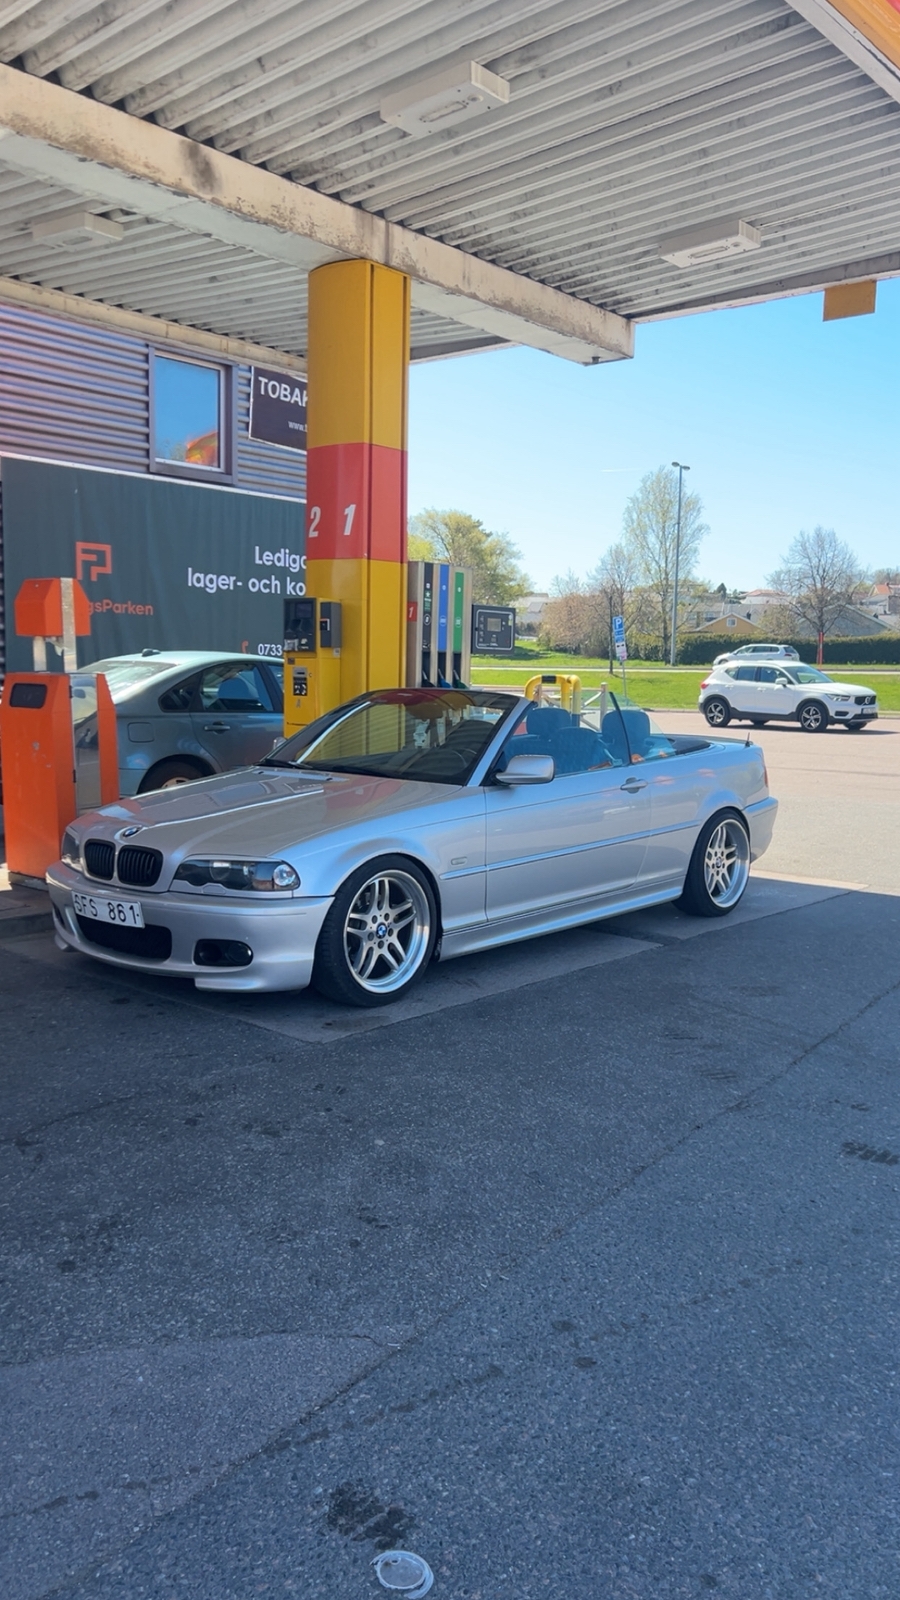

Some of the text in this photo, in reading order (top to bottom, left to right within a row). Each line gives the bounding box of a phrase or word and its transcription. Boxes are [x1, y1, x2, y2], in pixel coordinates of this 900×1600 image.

[308, 506, 321, 538] 2
[343, 503, 356, 536] 1
[187, 567, 243, 594] lager-
[248, 575, 281, 594] och
[408, 606, 414, 619] 1
[257, 643, 283, 656] 0733
[74, 894, 137, 925] SFS 861
